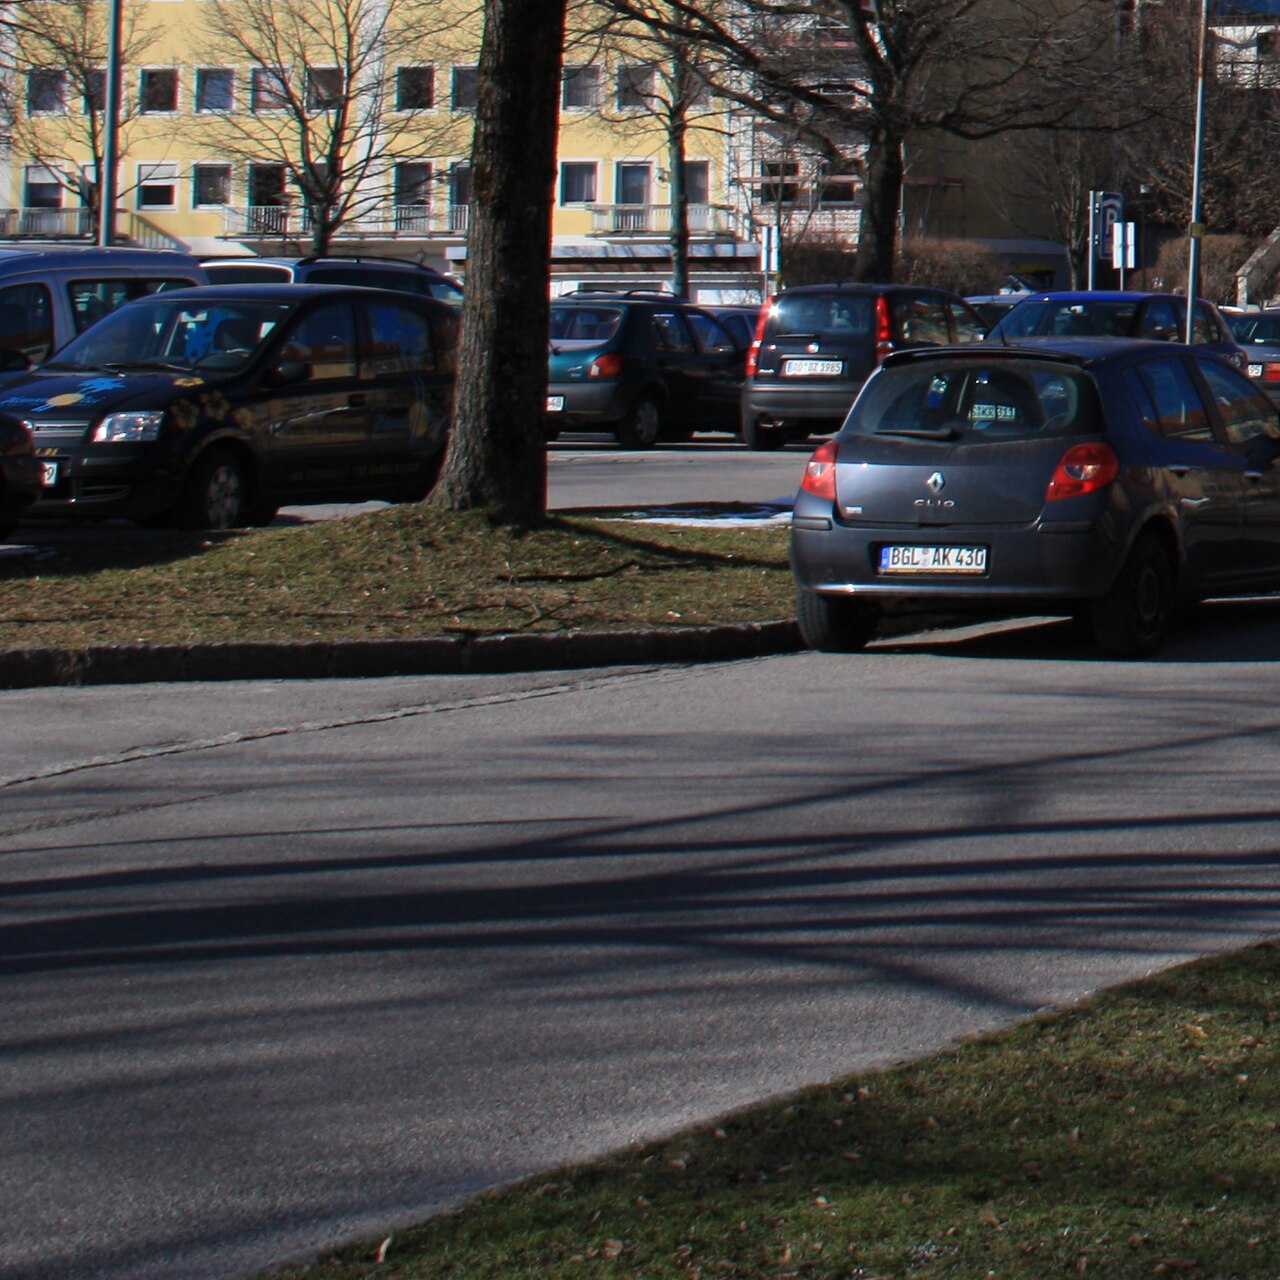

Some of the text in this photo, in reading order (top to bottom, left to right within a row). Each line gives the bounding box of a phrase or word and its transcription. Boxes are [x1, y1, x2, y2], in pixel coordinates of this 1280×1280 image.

[914, 499, 955, 507] CLIO
[891, 547, 985, 567] BGL AK 430
